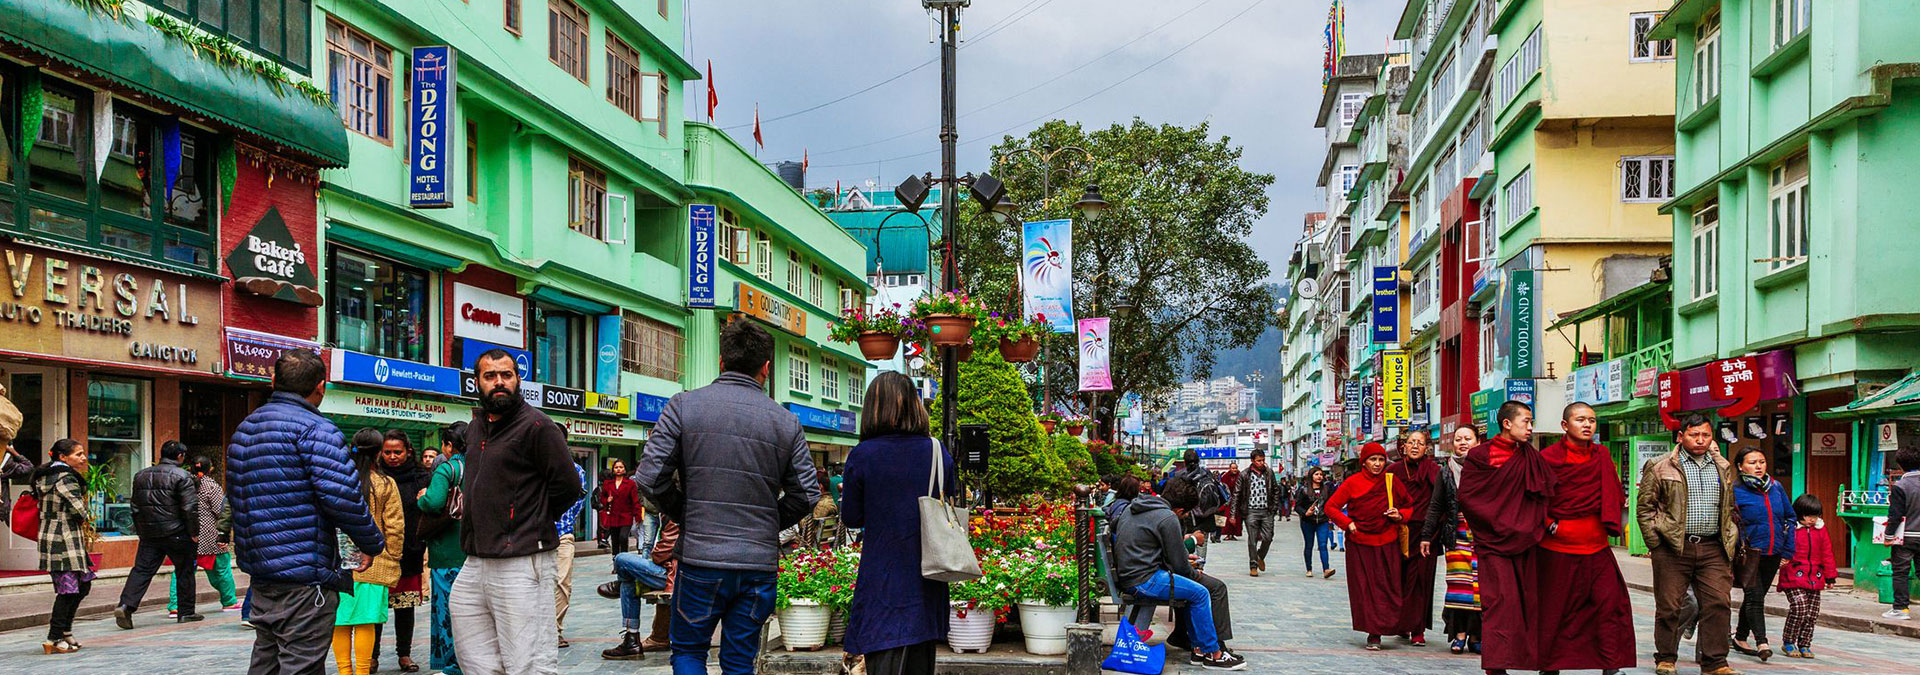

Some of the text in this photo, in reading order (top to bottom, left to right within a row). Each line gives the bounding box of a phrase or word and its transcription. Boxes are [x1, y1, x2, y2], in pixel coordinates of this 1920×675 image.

[420, 89, 438, 171] DZONG
[416, 176, 440, 184] HOTEL
[412, 192, 444, 200] RESTAURANT
[248, 234, 305, 264] Baker's
[696, 232, 708, 284] DZONG
[254, 254, 295, 278] Café
[5, 250, 199, 325] VERSAL
[461, 302, 501, 327] Canon
[760, 295, 781, 318] GOLDEN
[53, 309, 134, 336] TRADERS
[1518, 297, 1530, 369] WOODLAND
[130, 340, 198, 364] GANGTOK
[392, 368, 435, 382] Hewlett-Packard
[1392, 357, 1403, 392] house
[356, 396, 374, 406] HARI
[375, 398, 390, 408] RAM
[409, 402, 423, 412] LAL
[425, 404, 446, 414] SARDA
[546, 390, 580, 406] SONY
[597, 394, 618, 410] Nikon
[1392, 399, 1403, 419] roll
[392, 408, 416, 418] STUDENT
[574, 420, 624, 436] CONVERSE
